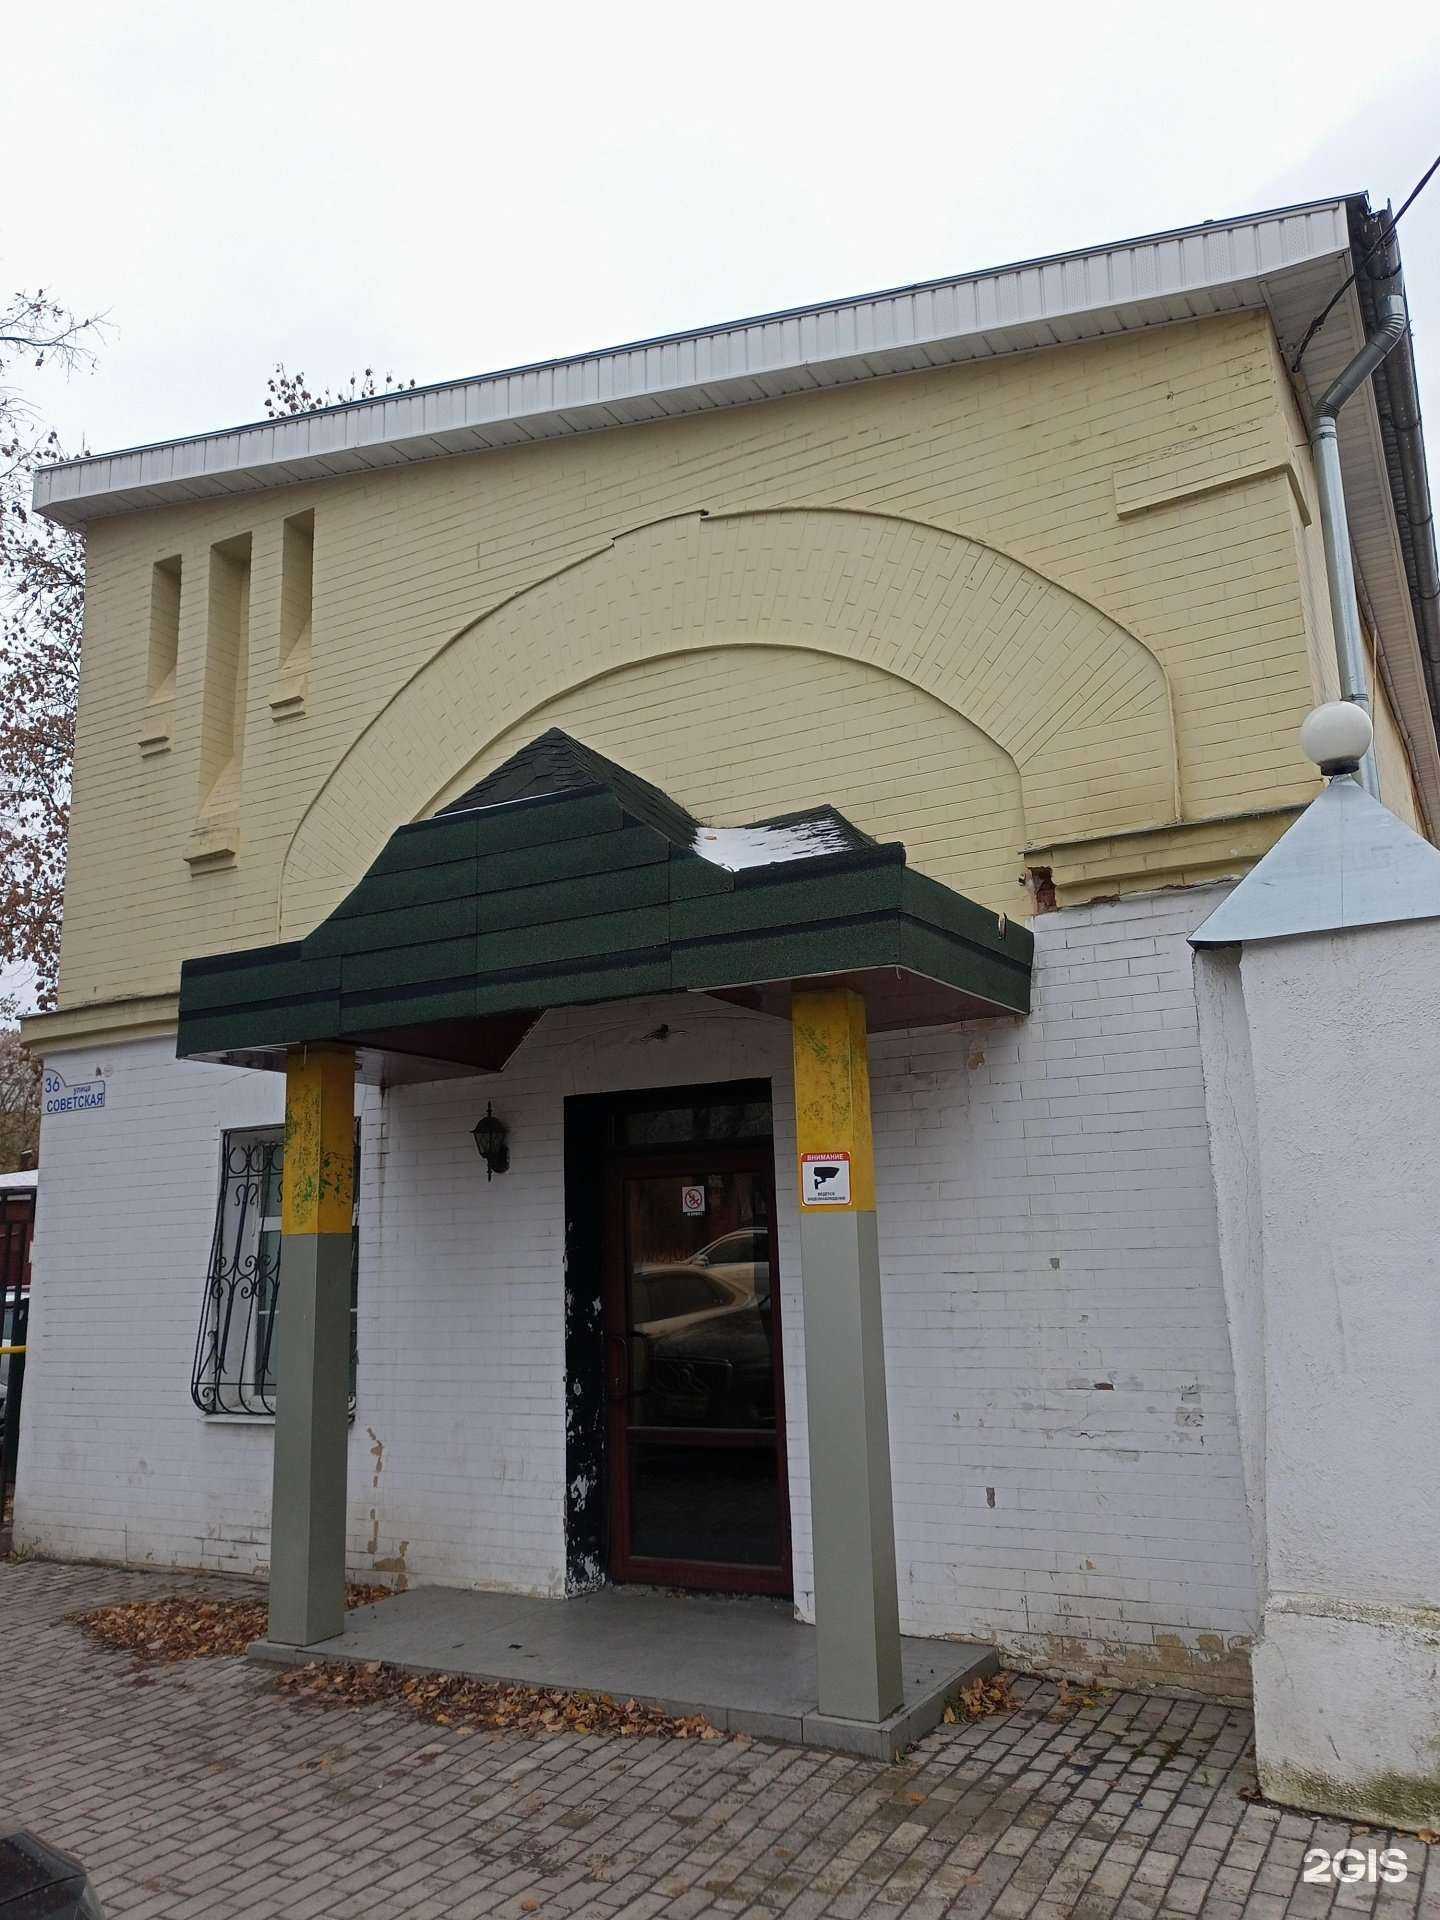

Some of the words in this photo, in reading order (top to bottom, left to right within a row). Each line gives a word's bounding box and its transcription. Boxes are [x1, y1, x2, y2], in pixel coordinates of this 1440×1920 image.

[45, 1077, 60, 1093] 36
[47, 1093, 103, 1112] СОВЕТСКАЯ
[807, 1153, 845, 1161] ВНИМАНИЕ
